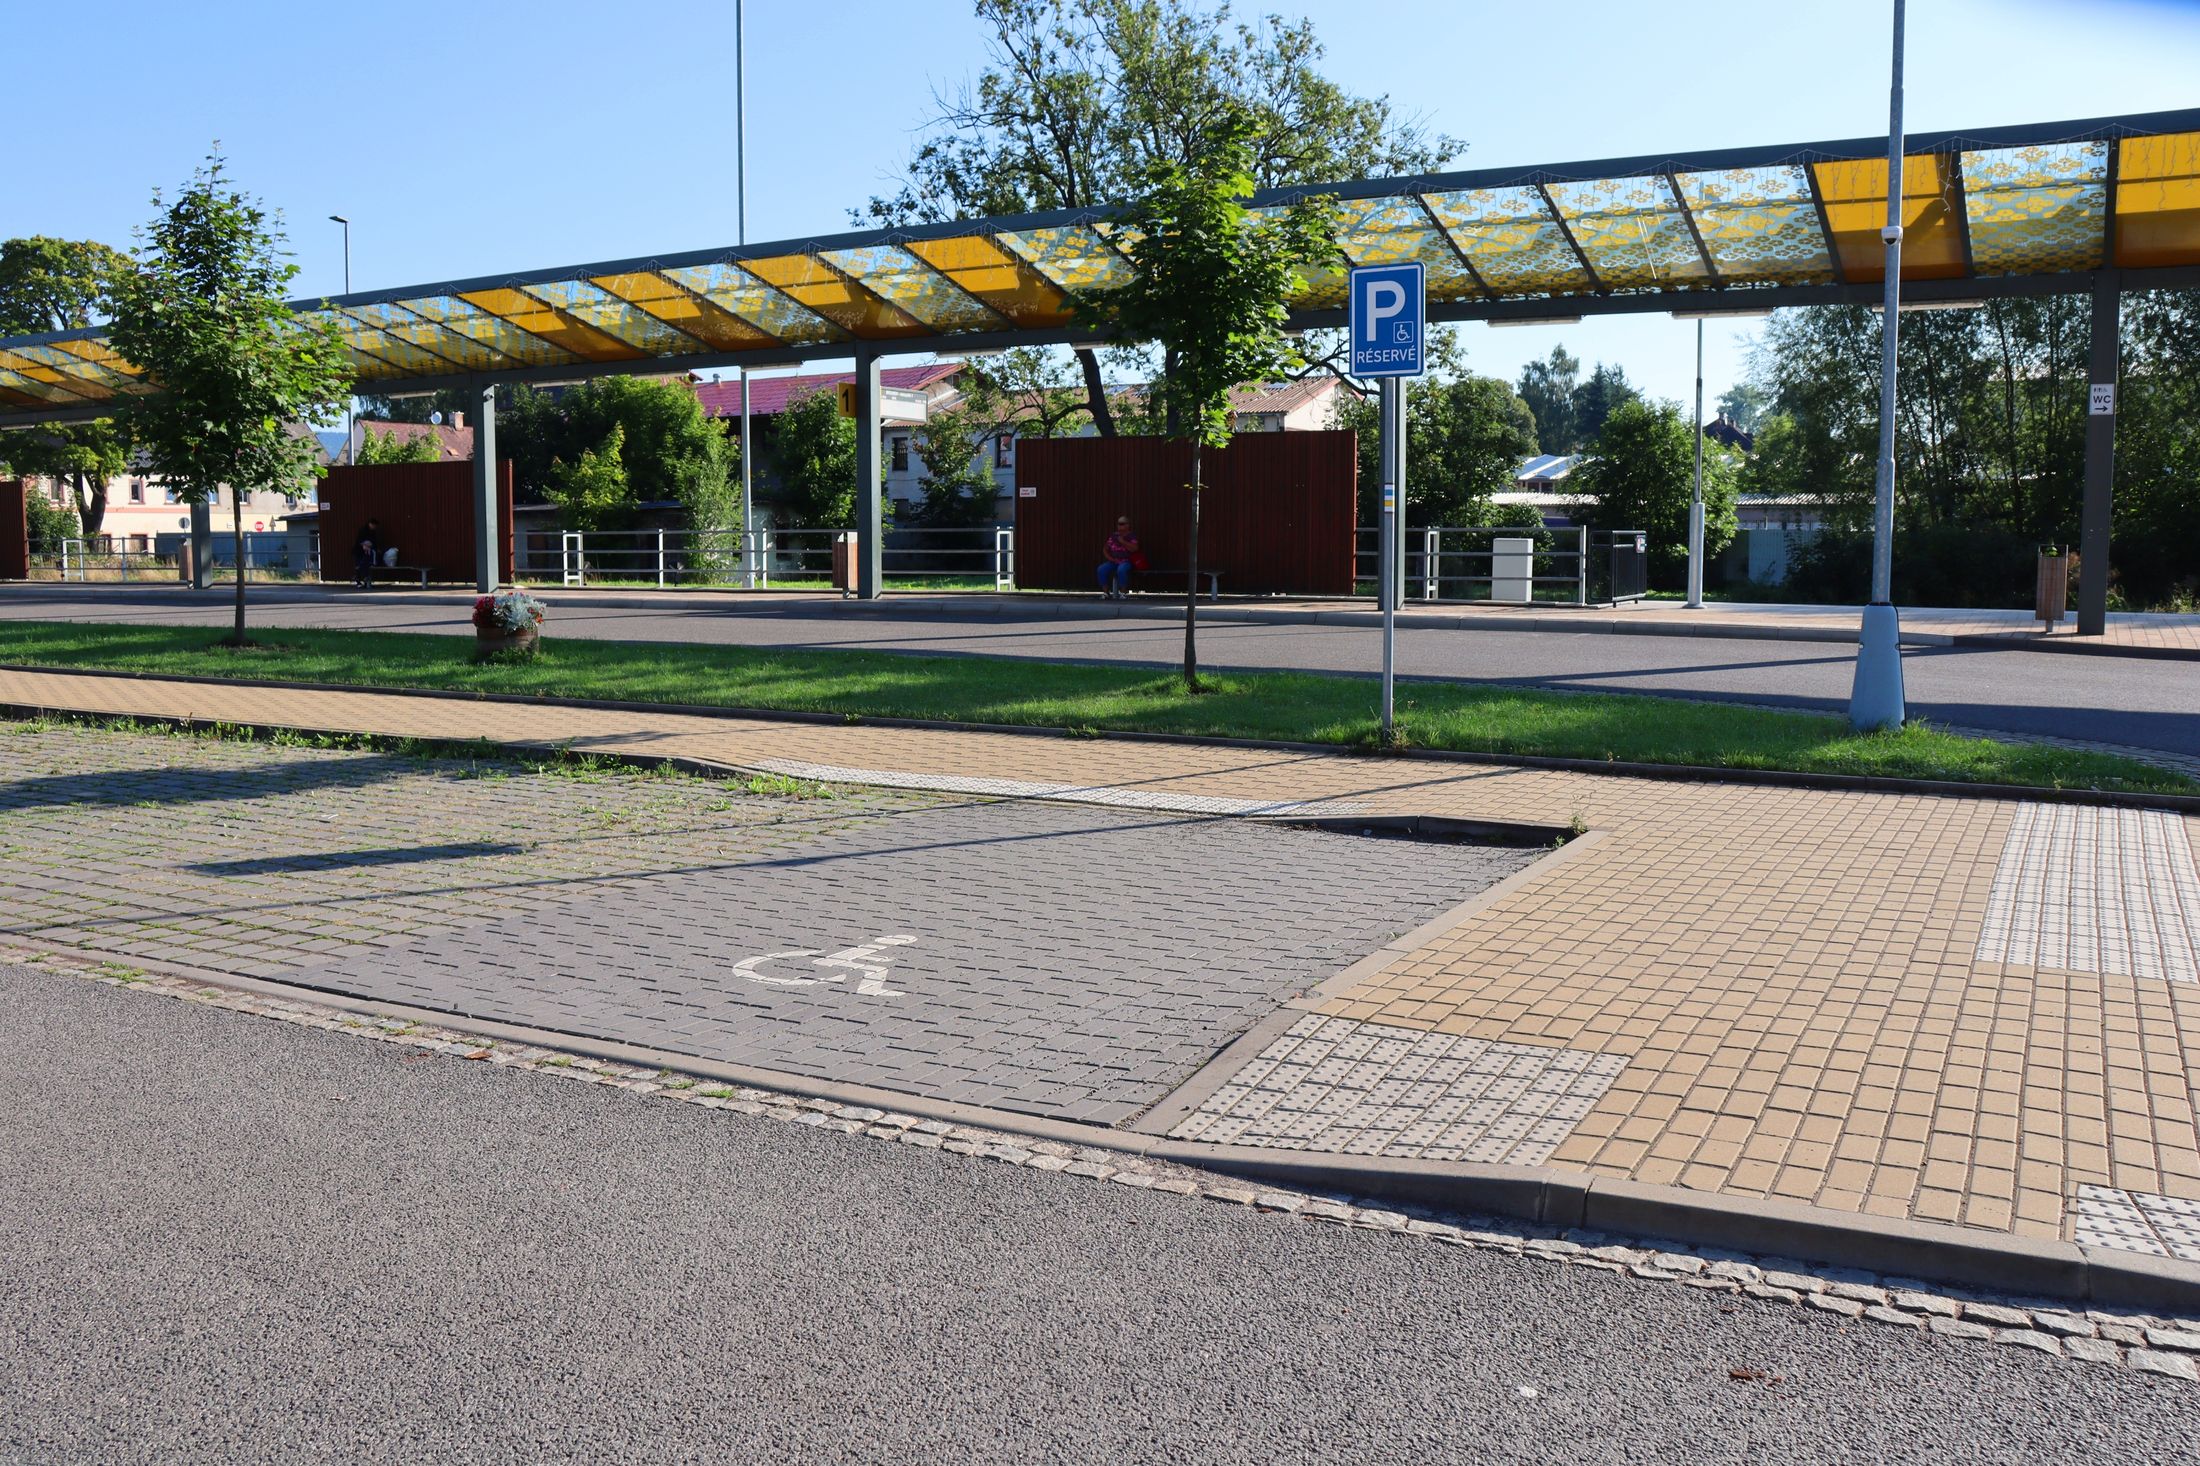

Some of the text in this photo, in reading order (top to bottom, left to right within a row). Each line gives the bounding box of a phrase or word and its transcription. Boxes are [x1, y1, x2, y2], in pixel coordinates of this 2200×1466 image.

[1366, 280, 1406, 342] P
[1357, 345, 1416, 363] RÉSERVÉ
[842, 388, 849, 412] 1
[2093, 395, 2111, 404] WC
